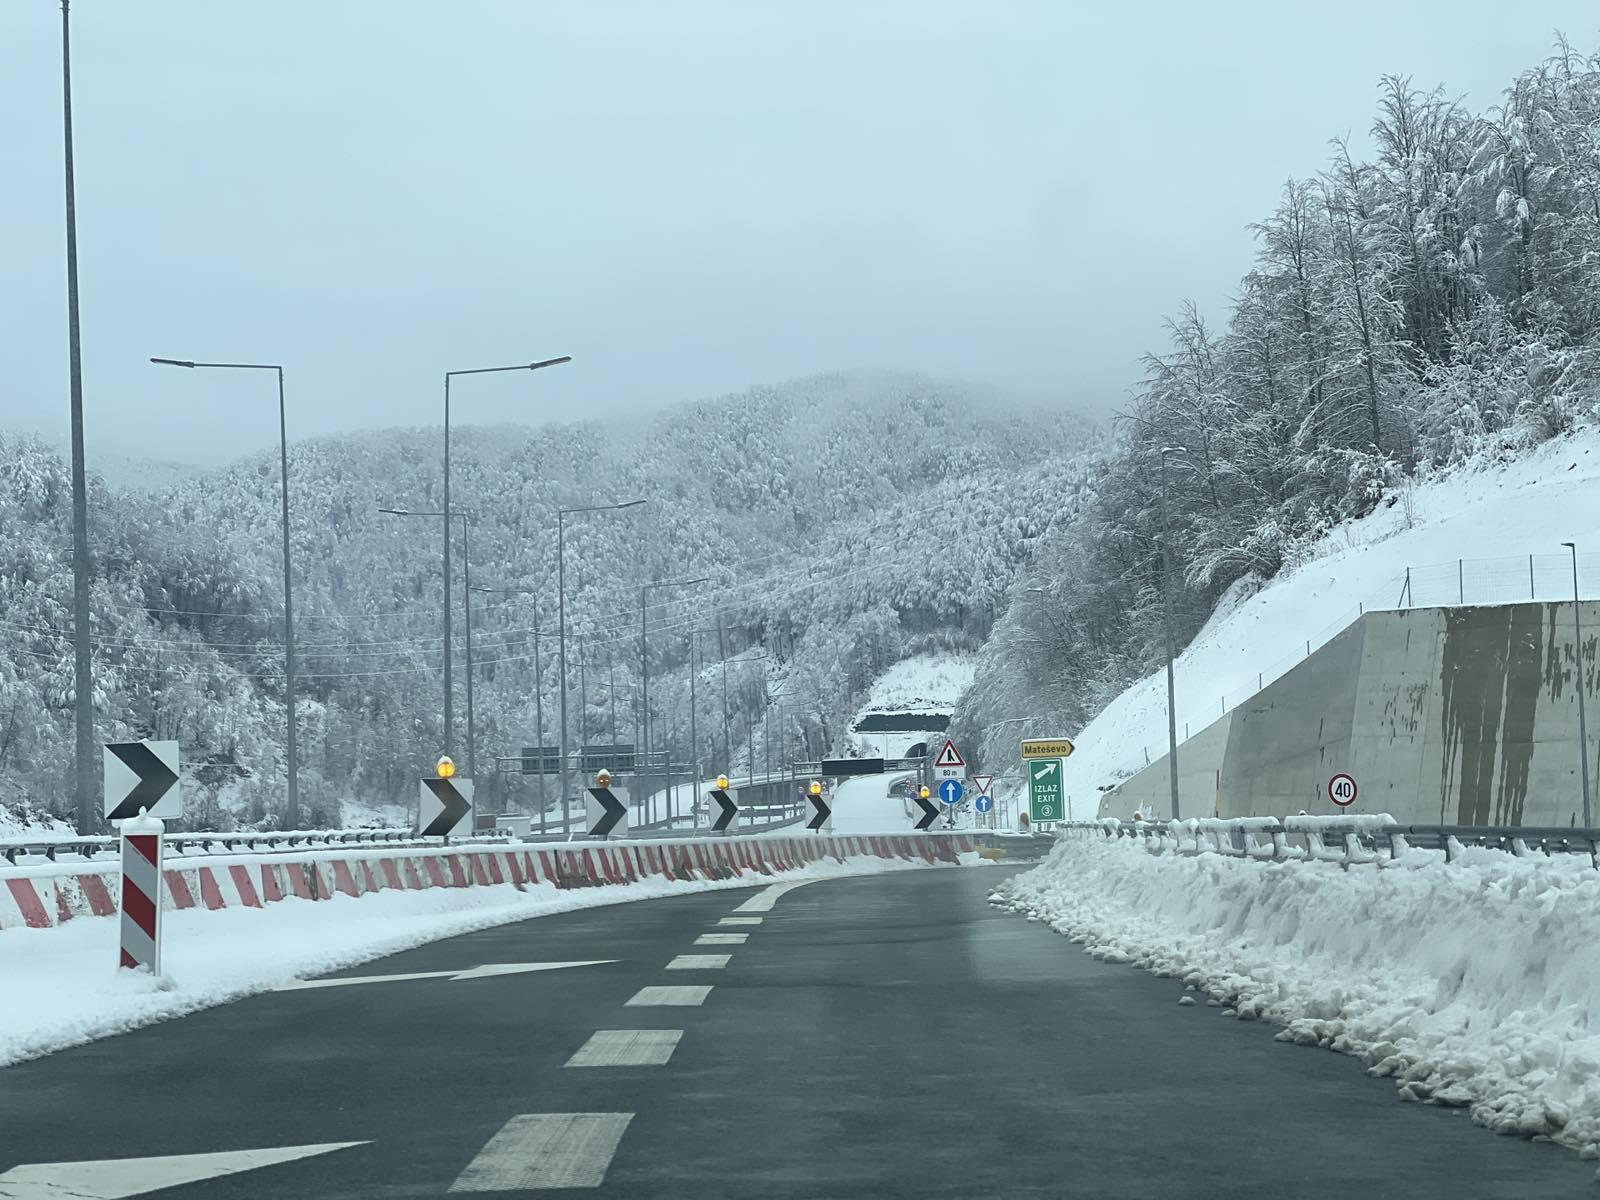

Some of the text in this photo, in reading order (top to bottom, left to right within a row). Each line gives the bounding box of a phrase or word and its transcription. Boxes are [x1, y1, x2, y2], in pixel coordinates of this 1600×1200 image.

[1024, 745, 1067, 754] Mateševo
[1034, 784, 1058, 792] IZLAZ
[1334, 782, 1351, 798] 40
[1037, 794, 1055, 802] EXIT
